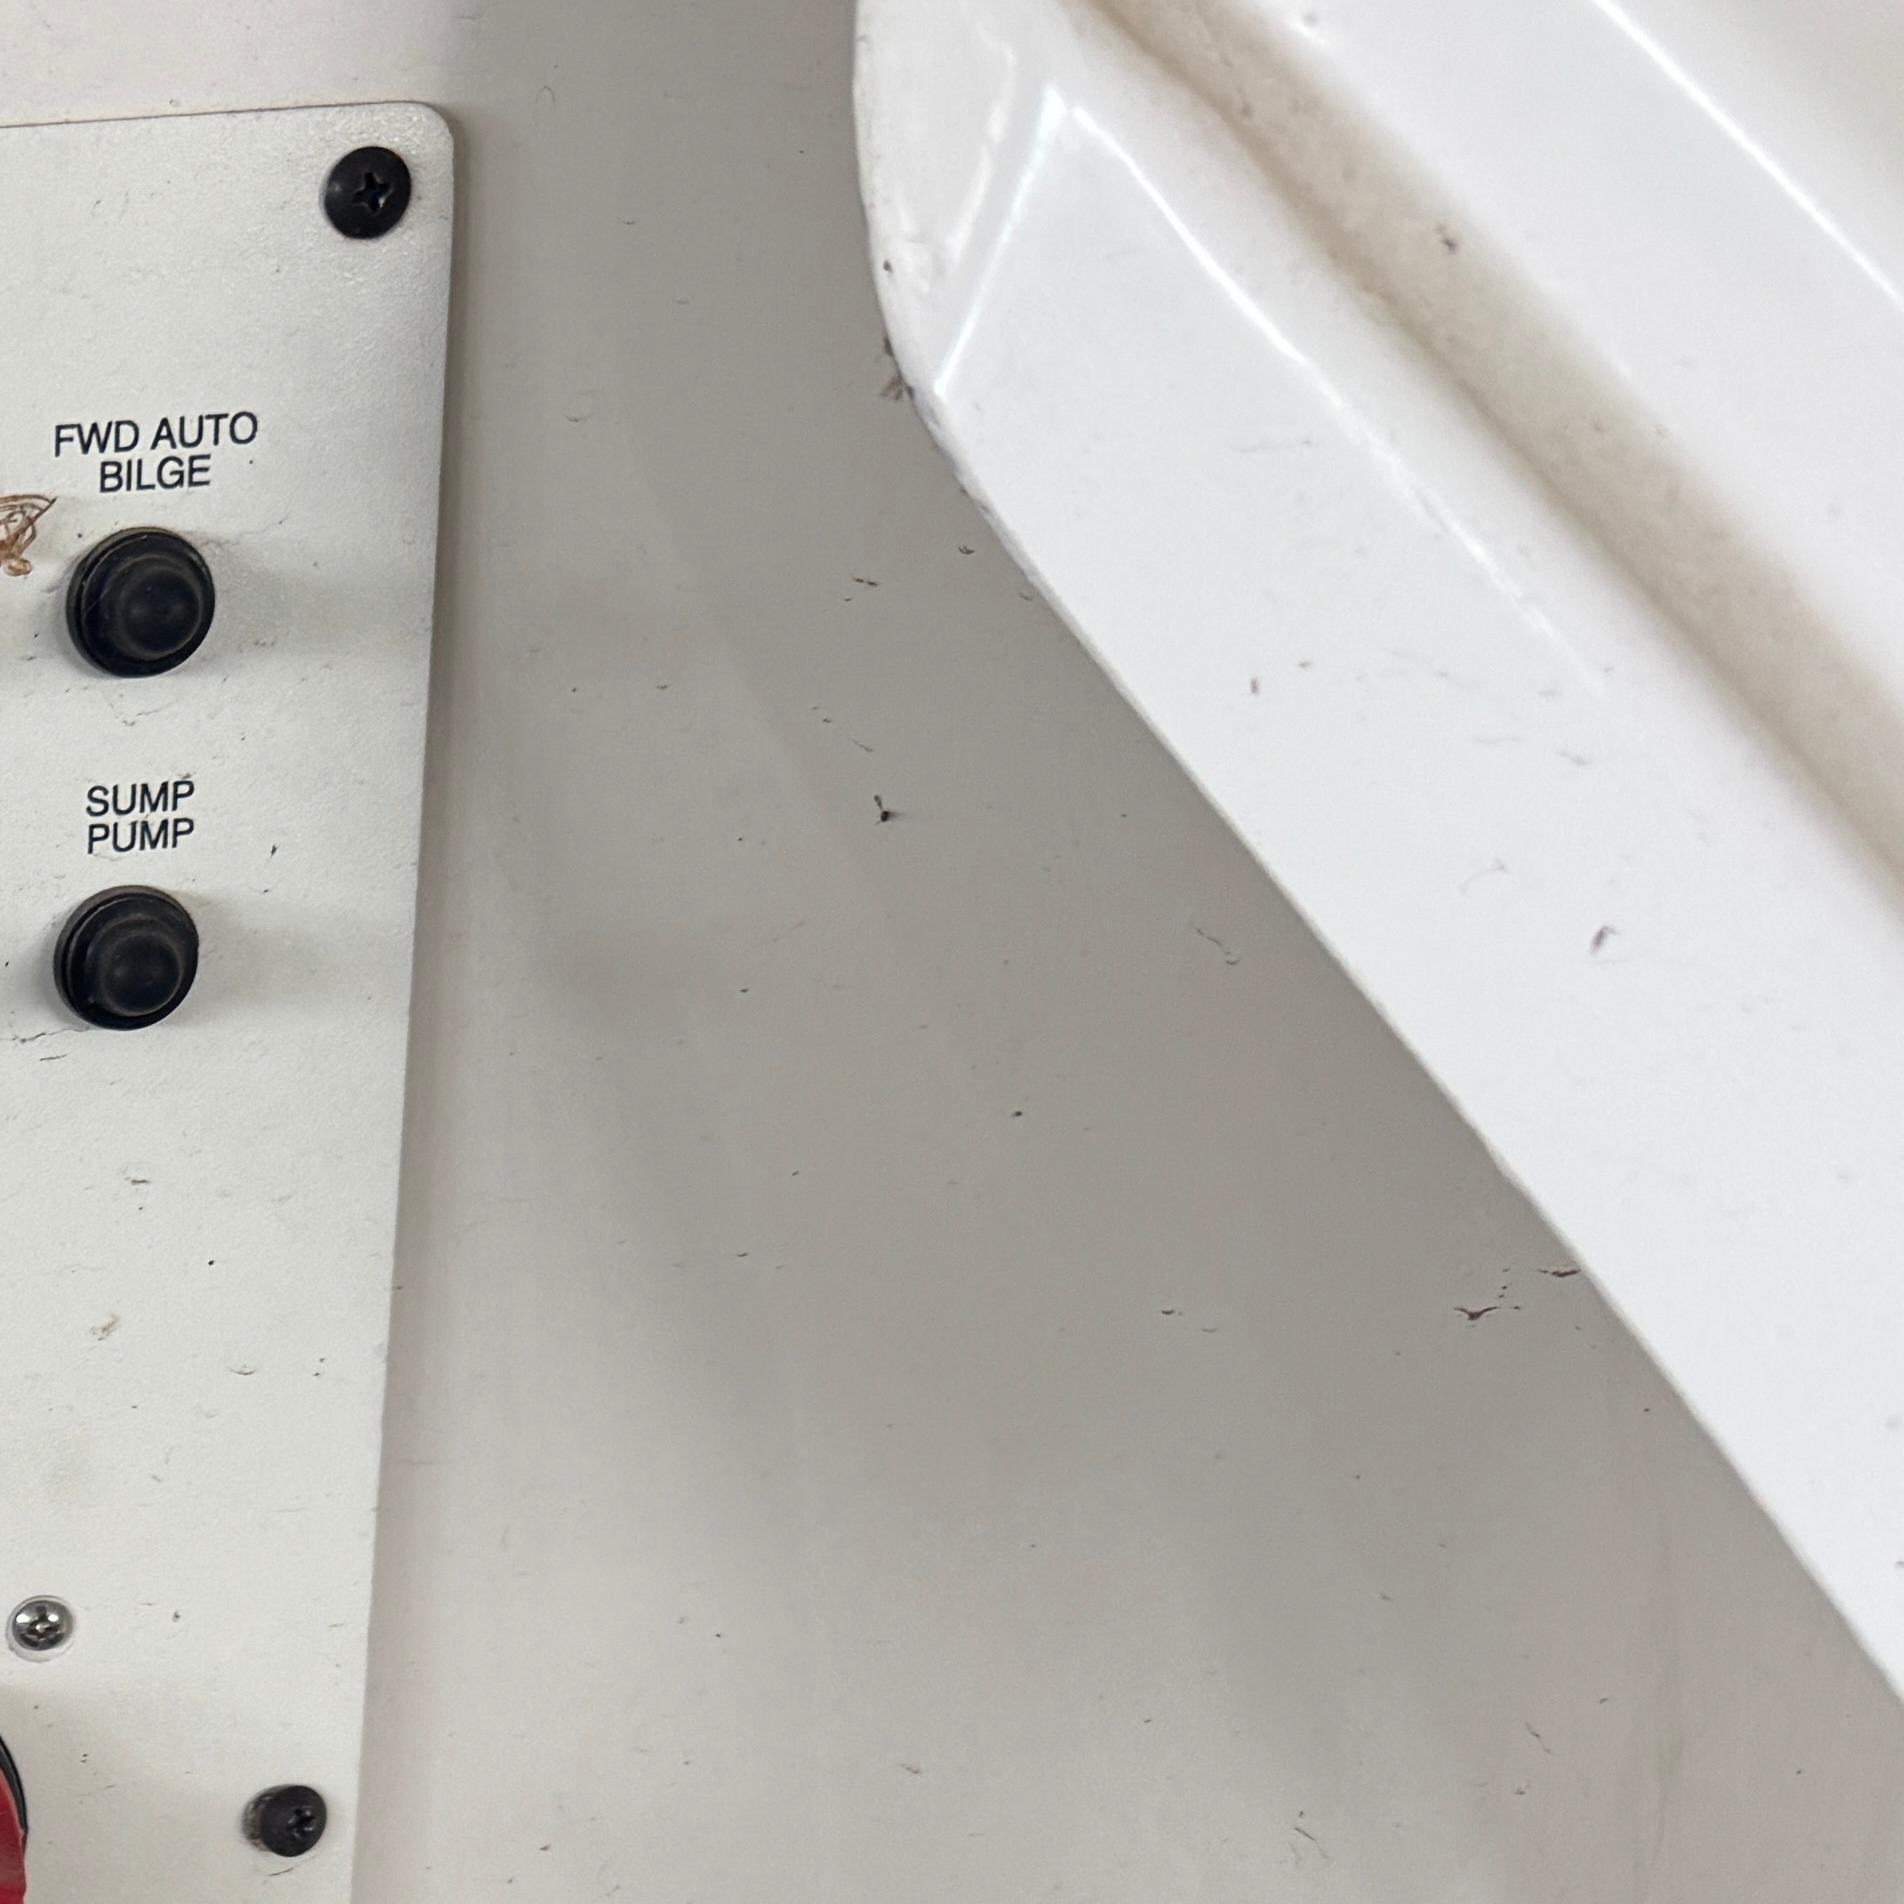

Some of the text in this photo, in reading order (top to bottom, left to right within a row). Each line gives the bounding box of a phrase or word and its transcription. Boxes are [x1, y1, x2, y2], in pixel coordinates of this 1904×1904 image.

[54, 410, 259, 458] FWD AUTO
[99, 453, 212, 494] BILGE
[85, 779, 196, 818] SUMP
[87, 816, 195, 855] PUMP
